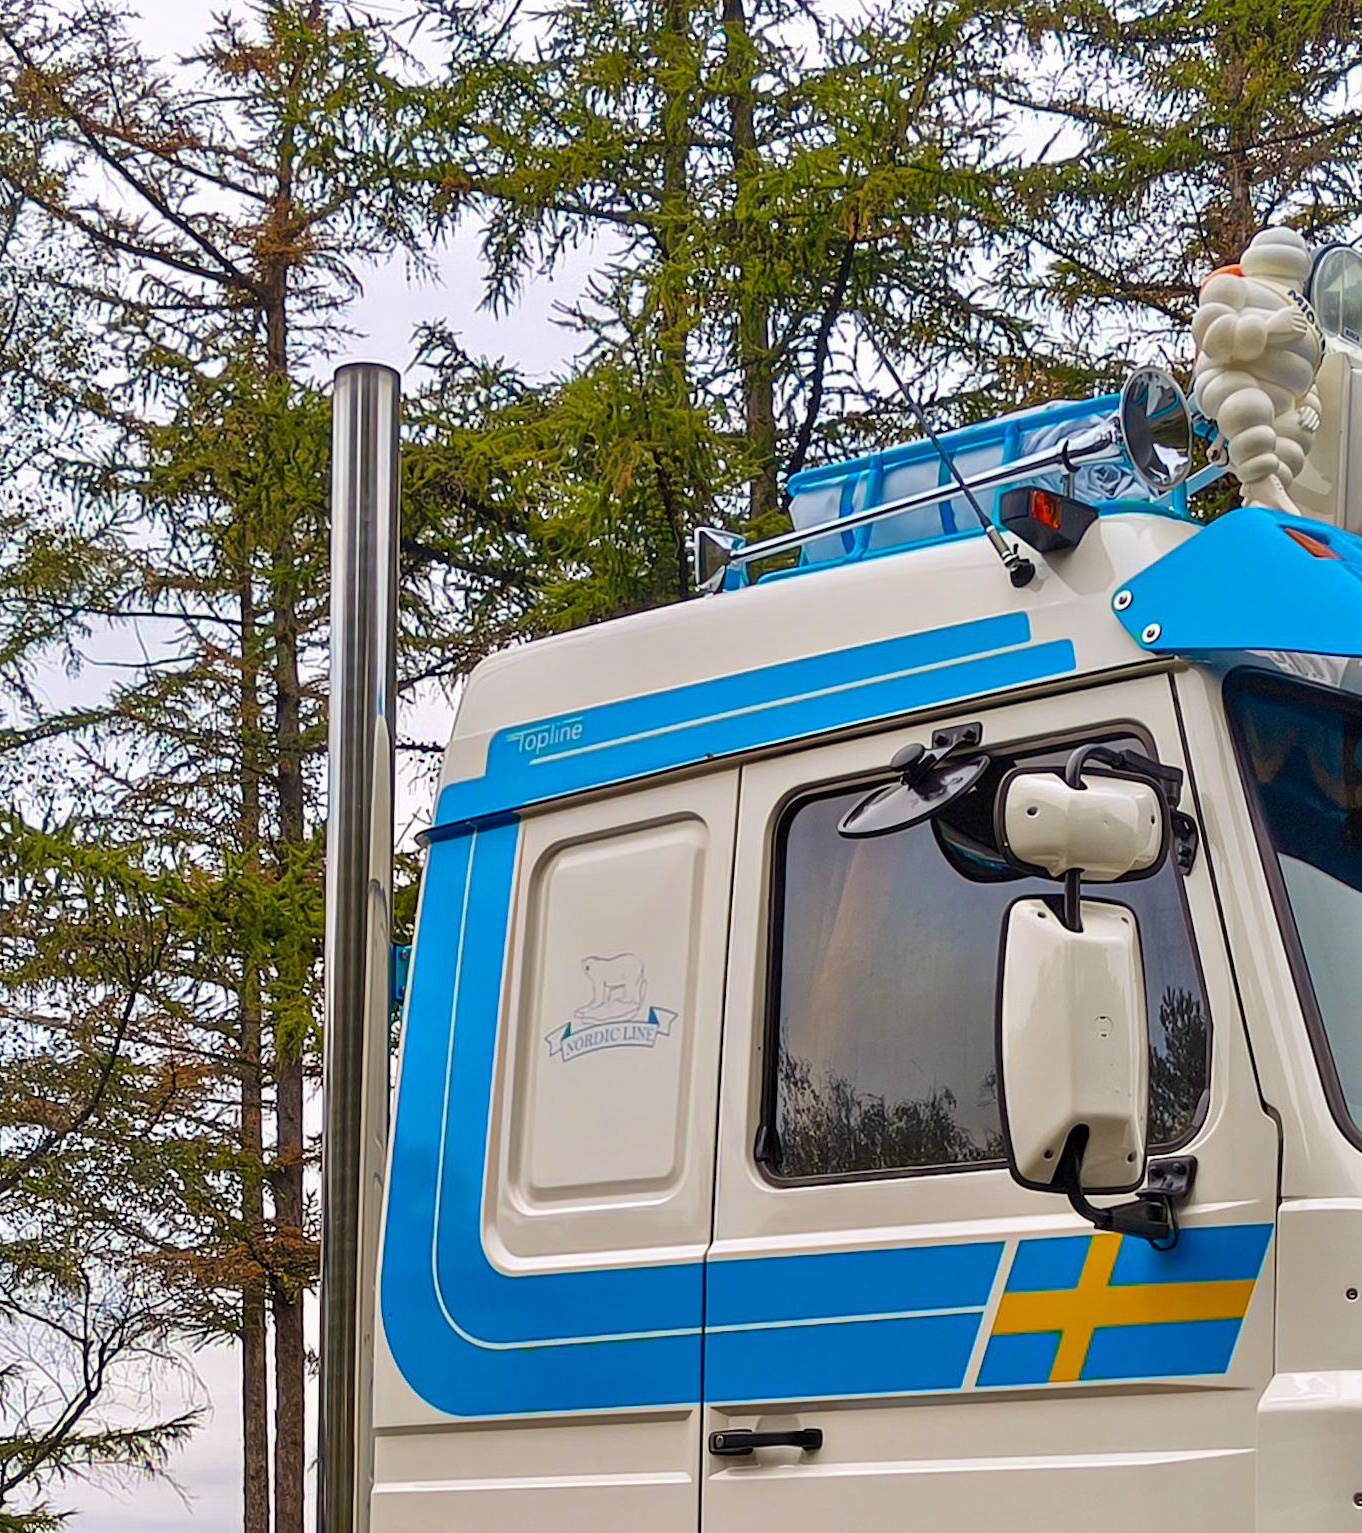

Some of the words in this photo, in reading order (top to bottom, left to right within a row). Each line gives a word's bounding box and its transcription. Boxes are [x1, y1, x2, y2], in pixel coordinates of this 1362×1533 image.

[506, 716, 584, 755] Topline
[566, 1027, 620, 1056] NORDIC
[623, 1025, 655, 1042] LINE
